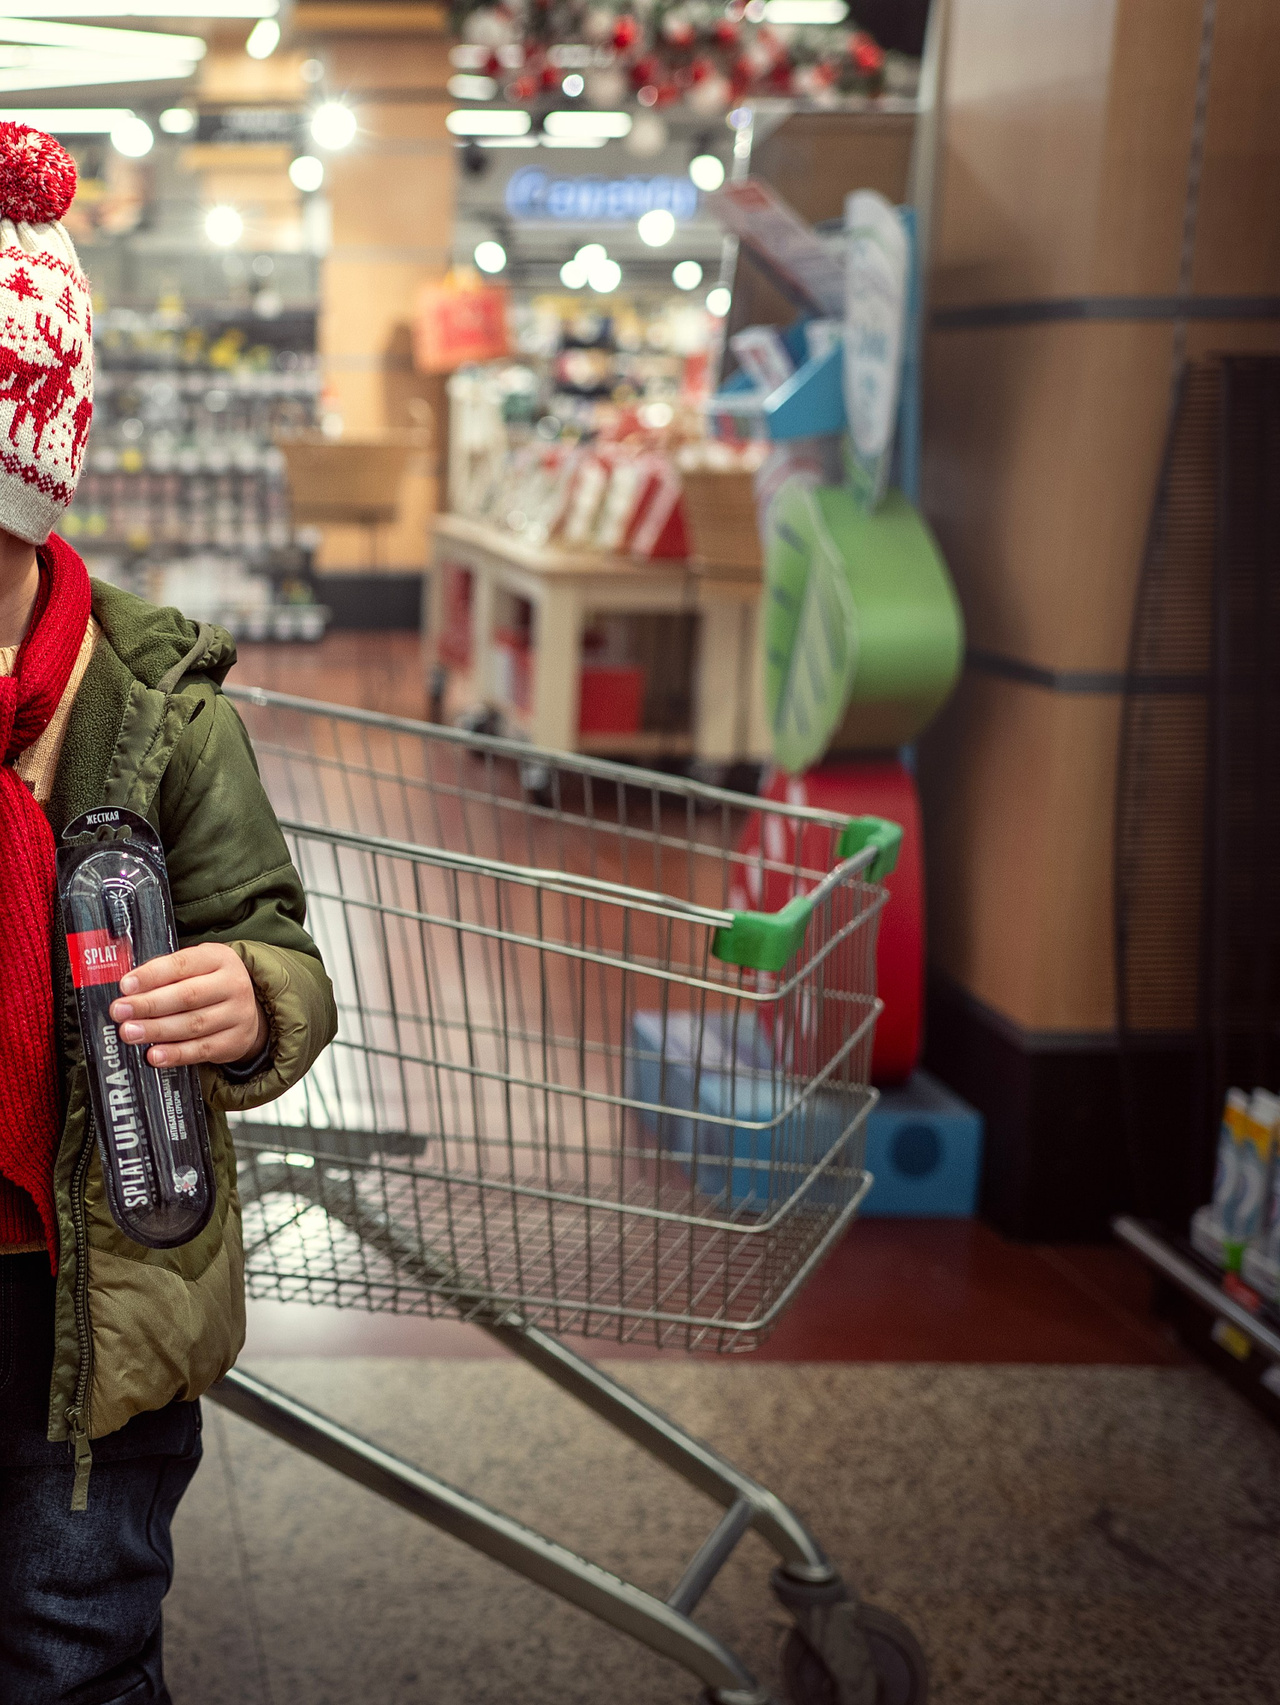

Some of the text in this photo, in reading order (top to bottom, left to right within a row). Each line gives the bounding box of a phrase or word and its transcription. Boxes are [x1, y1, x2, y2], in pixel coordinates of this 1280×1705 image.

[85, 810, 120, 825] ЖЕСТКАЯ
[83, 945, 118, 965] SPLAT
[87, 962, 119, 971] PROFESSIONAL
[102, 1024, 149, 1209] SPLAT ULTRA clean
[161, 1078, 180, 1141] АНТИБАКТЕРИАЛЬНАЯ
